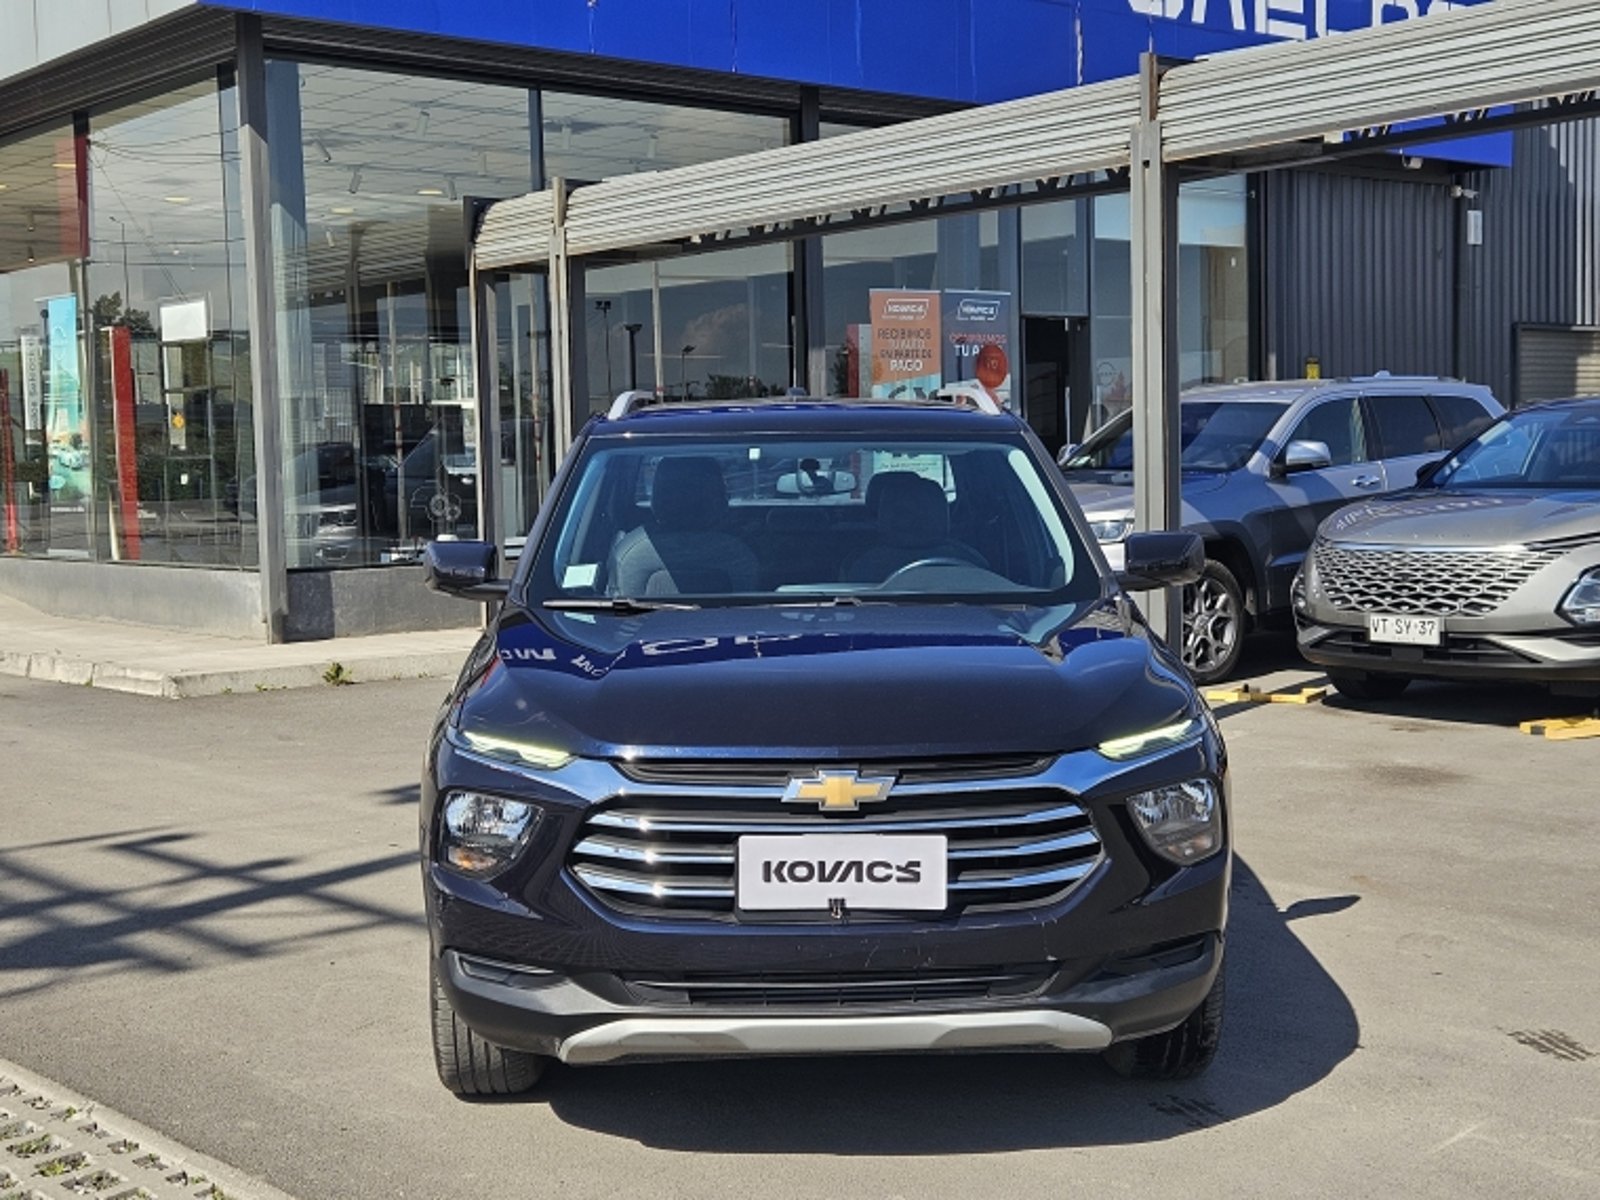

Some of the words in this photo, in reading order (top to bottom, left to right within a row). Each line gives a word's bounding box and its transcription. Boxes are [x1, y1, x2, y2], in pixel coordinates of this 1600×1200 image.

[954, 345, 969, 357] TU
[889, 359, 923, 371] PAGO
[1372, 618, 1389, 634] VT
[1395, 618, 1412, 635] SY
[1418, 620, 1435, 636] 37
[762, 860, 921, 883] KOVACS
